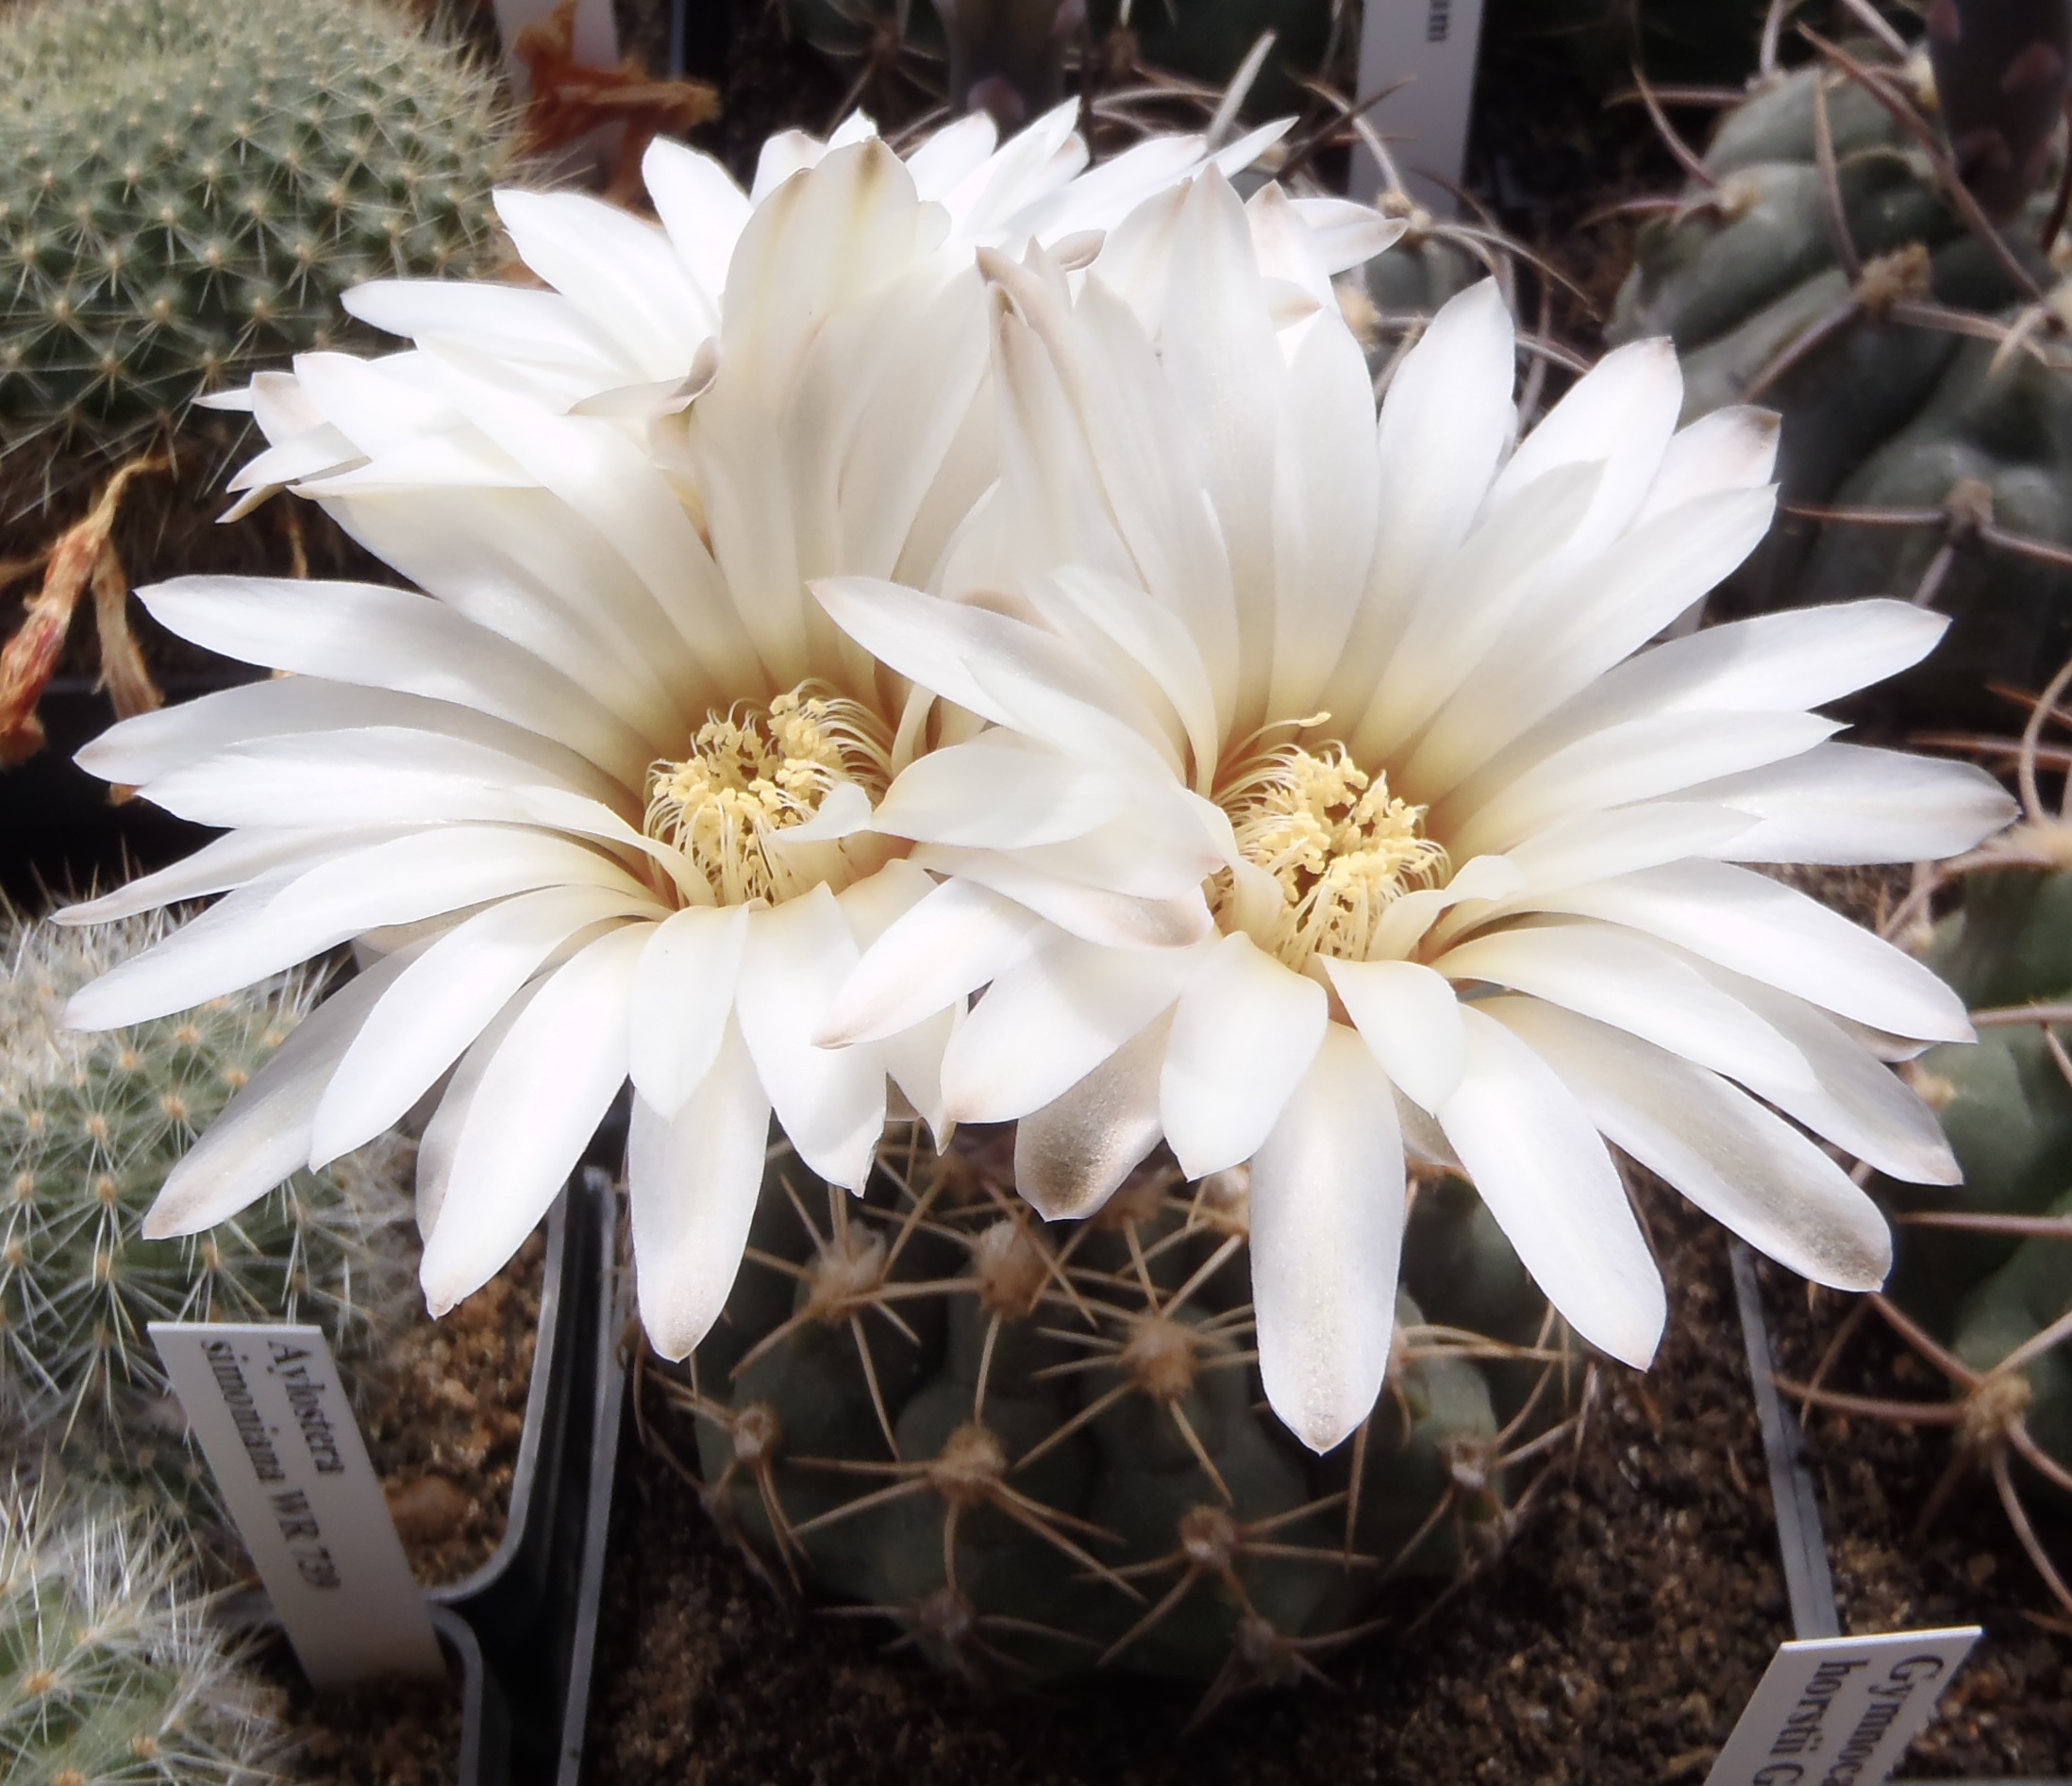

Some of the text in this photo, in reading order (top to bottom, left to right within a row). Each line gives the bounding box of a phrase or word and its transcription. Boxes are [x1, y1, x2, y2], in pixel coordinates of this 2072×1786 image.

[201, 1341, 286, 1481] simoniana
[270, 1490, 319, 1542] WR
[267, 1342, 344, 1473] Aylostera
[1770, 1661, 1869, 1753] horstii
